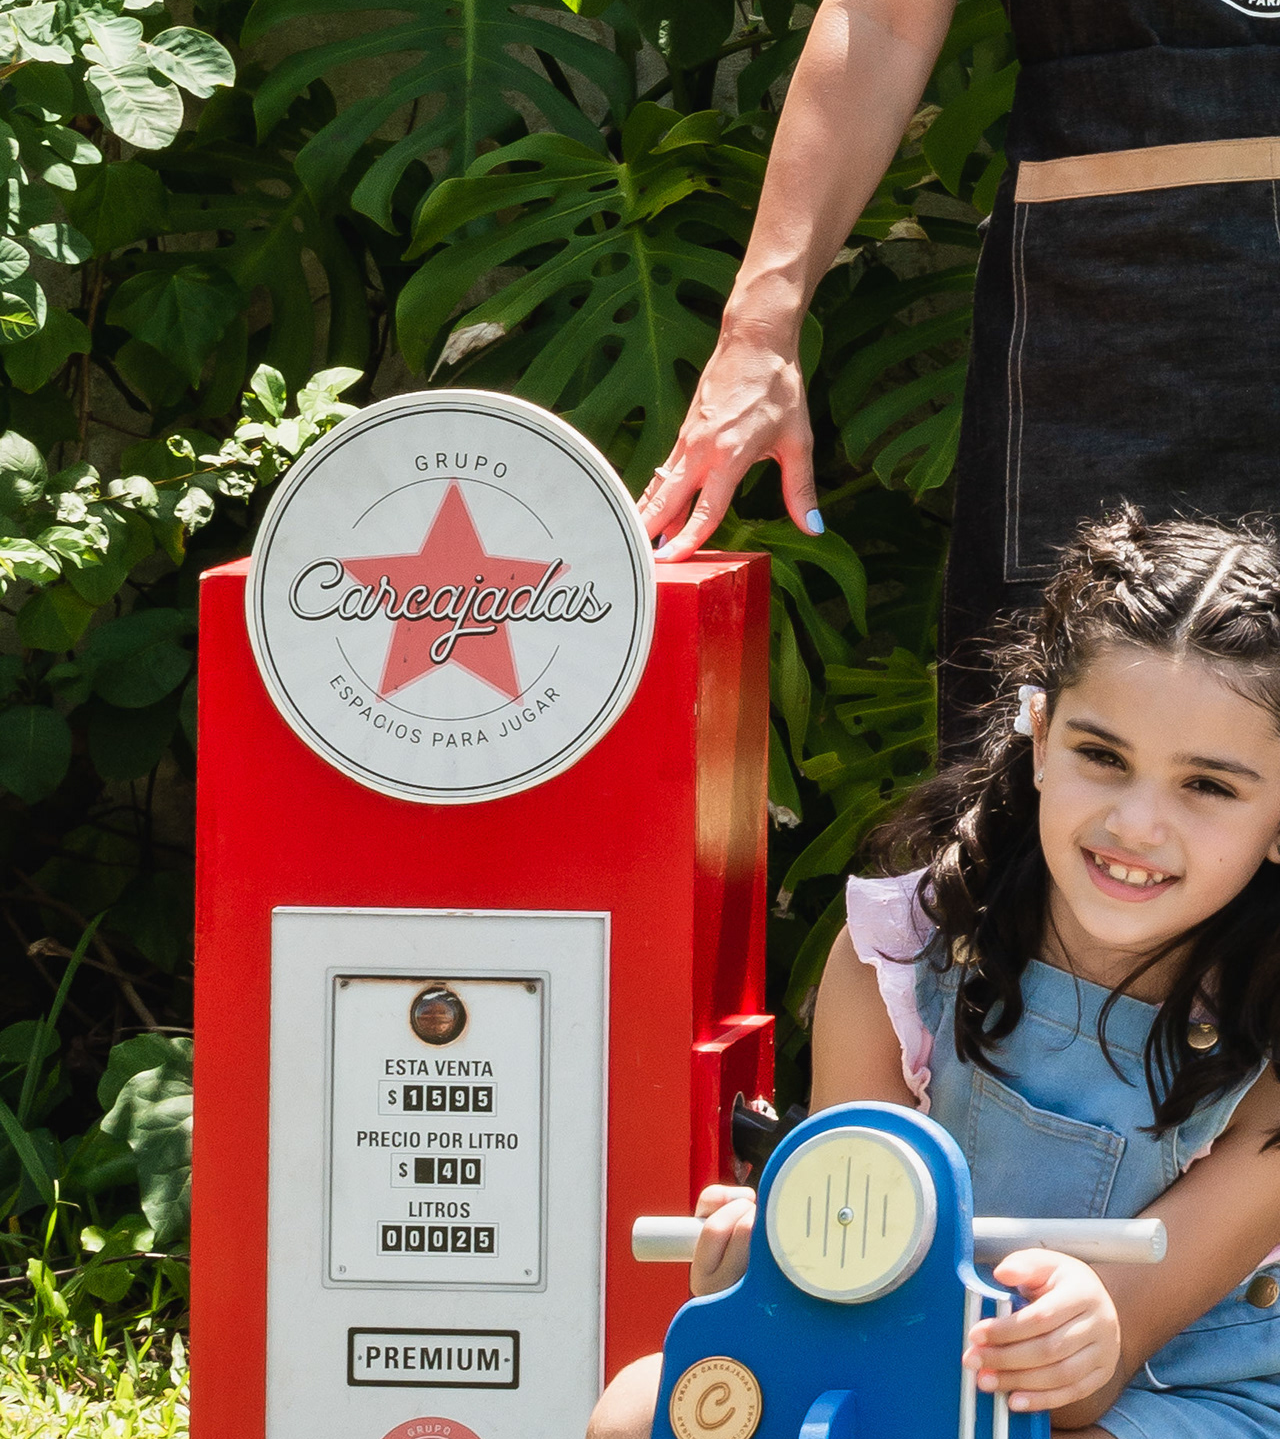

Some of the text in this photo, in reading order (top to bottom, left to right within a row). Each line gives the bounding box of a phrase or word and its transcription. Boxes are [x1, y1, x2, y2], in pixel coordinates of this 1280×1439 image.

[414, 453, 509, 478] GRUPO
[288, 557, 612, 664] Carcajadas
[328, 673, 562, 748] ESPACIOS PARA JUGAR
[385, 1059, 493, 1077] ESTA VENTA
[356, 1131, 519, 1150] PRECIO POR LITRO
[408, 1202, 471, 1219] LITROS
[365, 1346, 500, 1371] PREMIUM
[695, 1381, 736, 1430] C
[407, 1424, 452, 1438] GRUPO
